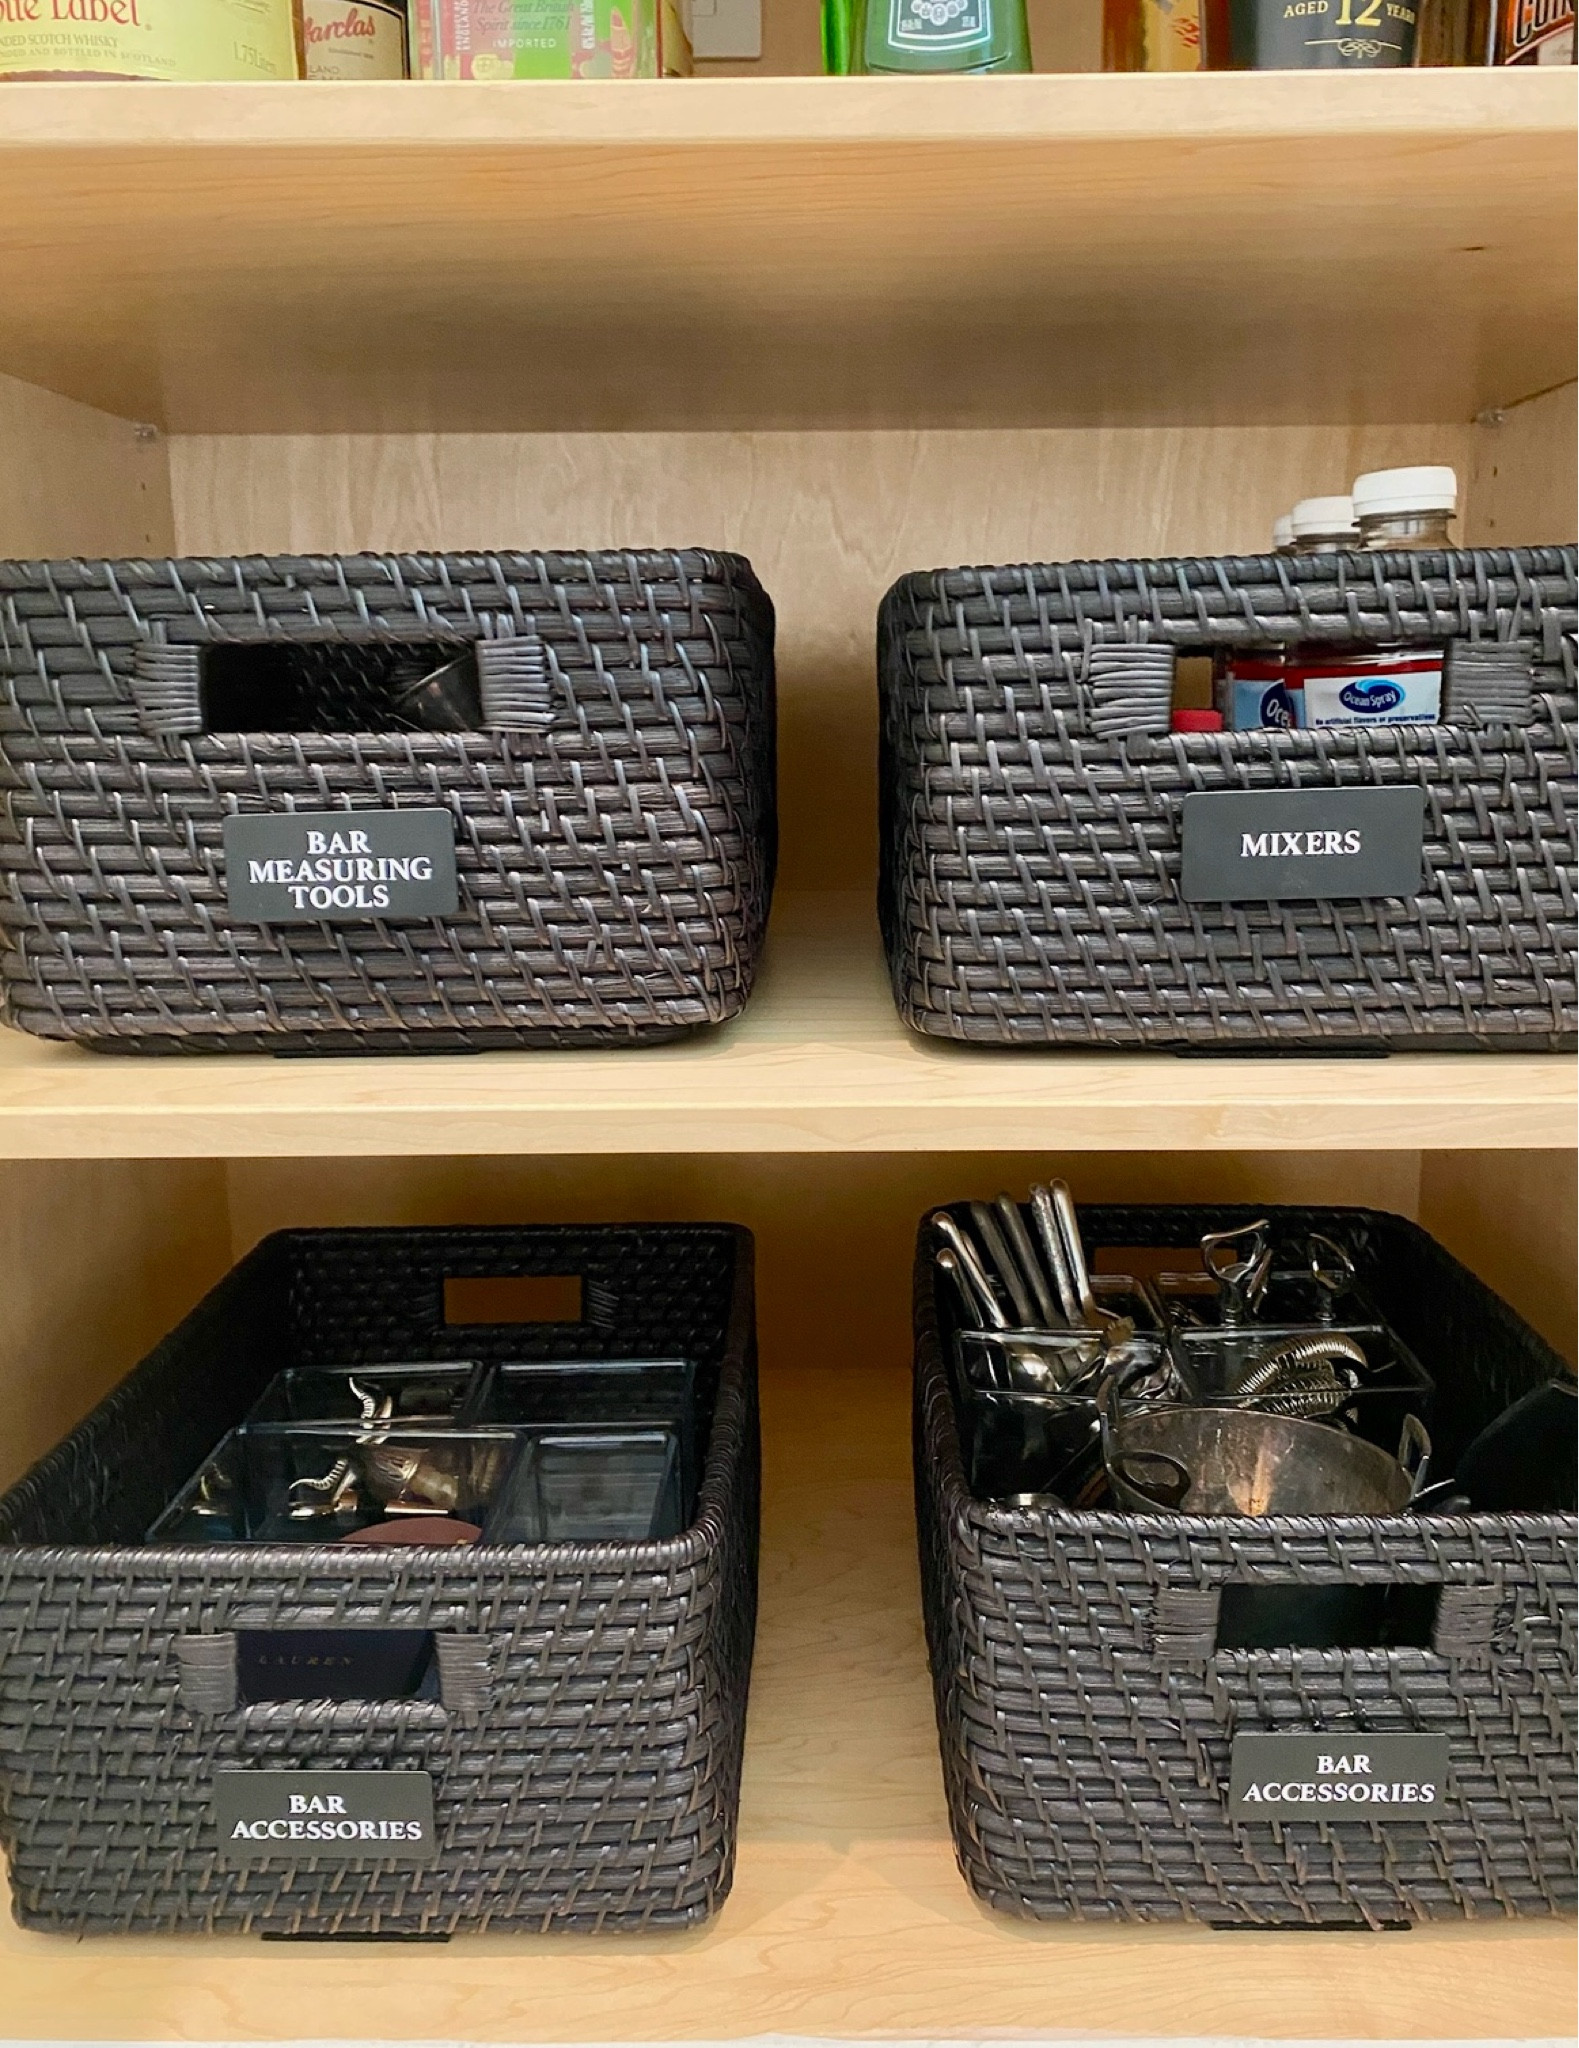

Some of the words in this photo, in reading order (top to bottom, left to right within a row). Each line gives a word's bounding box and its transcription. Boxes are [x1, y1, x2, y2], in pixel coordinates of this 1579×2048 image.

[51, 0, 140, 26] Label
[1283, 1, 1329, 18] AGED
[1335, 0, 1381, 26] 12
[28, 34, 71, 46] SCOTCH
[73, 35, 119, 47] WHISKY
[493, 38, 557, 49] IMPORTED
[30, 48, 50, 56] AND
[53, 48, 101, 58] BOTTLED
[104, 50, 117, 58] IN
[120, 52, 176, 66] SCOTLAND
[1342, 691, 1371, 706] Ocean
[1370, 690, 1397, 708] Spray
[306, 830, 372, 855] BAR
[1240, 829, 1361, 857] MIXERS
[248, 856, 432, 883] MEASURING
[288, 884, 389, 909] TOOLS
[1316, 1755, 1372, 1774] BAR
[1242, 1782, 1436, 1803] ACCESSORIES
[288, 1795, 346, 1814] BAR
[230, 1820, 422, 1840] ACCESSORIES
